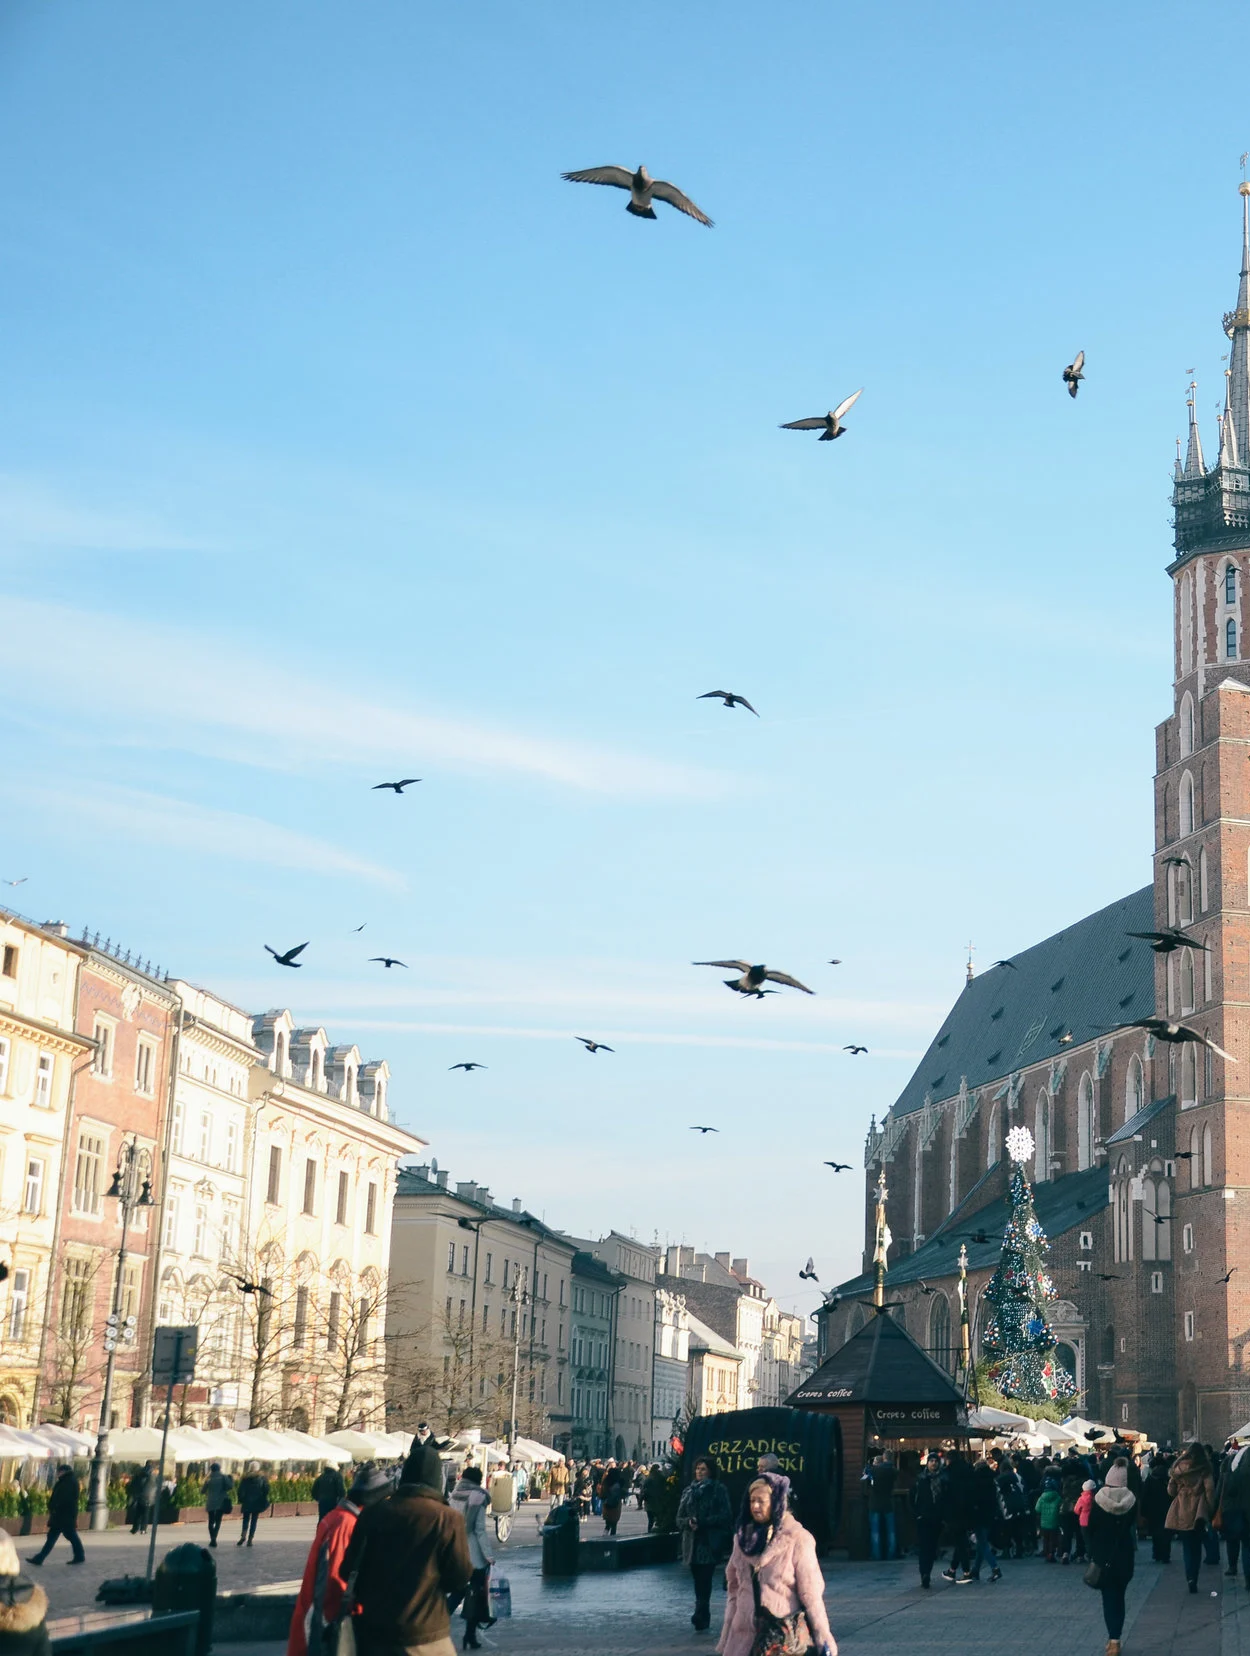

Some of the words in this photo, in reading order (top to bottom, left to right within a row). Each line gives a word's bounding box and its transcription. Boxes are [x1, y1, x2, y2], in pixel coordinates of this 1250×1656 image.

[827, 1388, 853, 1398] coffee
[911, 1408, 941, 1420] coffee
[708, 1438, 801, 1454] GRZANIEC
[715, 1454, 805, 1473] ALICSKI
